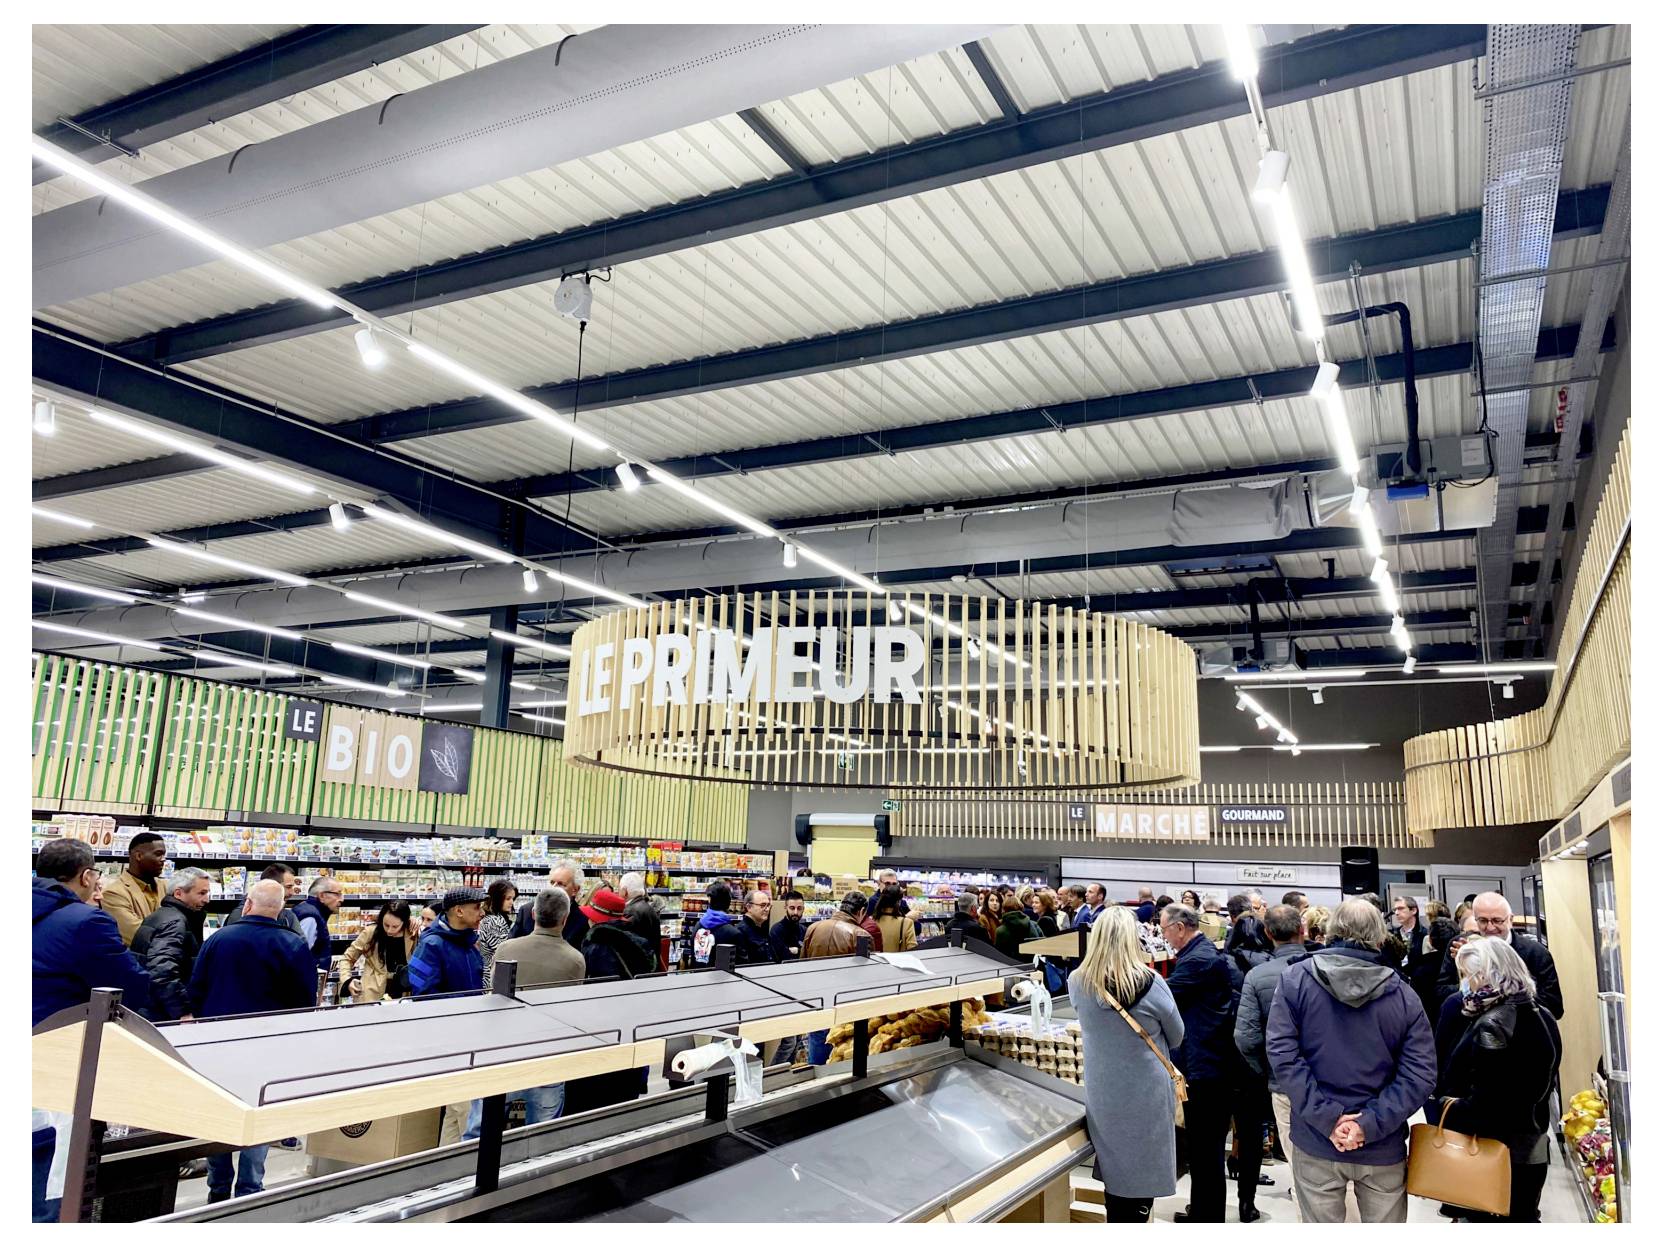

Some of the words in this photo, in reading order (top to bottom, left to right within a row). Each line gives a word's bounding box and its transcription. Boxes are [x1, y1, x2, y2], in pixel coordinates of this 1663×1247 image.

[579, 645, 613, 717] LE
[620, 626, 925, 710] PRIMEUR
[292, 709, 317, 733] LE
[327, 725, 413, 778] BIO
[1071, 807, 1084, 818] LE
[1096, 810, 1206, 836] MARCHÉ
[1222, 809, 1285, 821] GOURMAND
